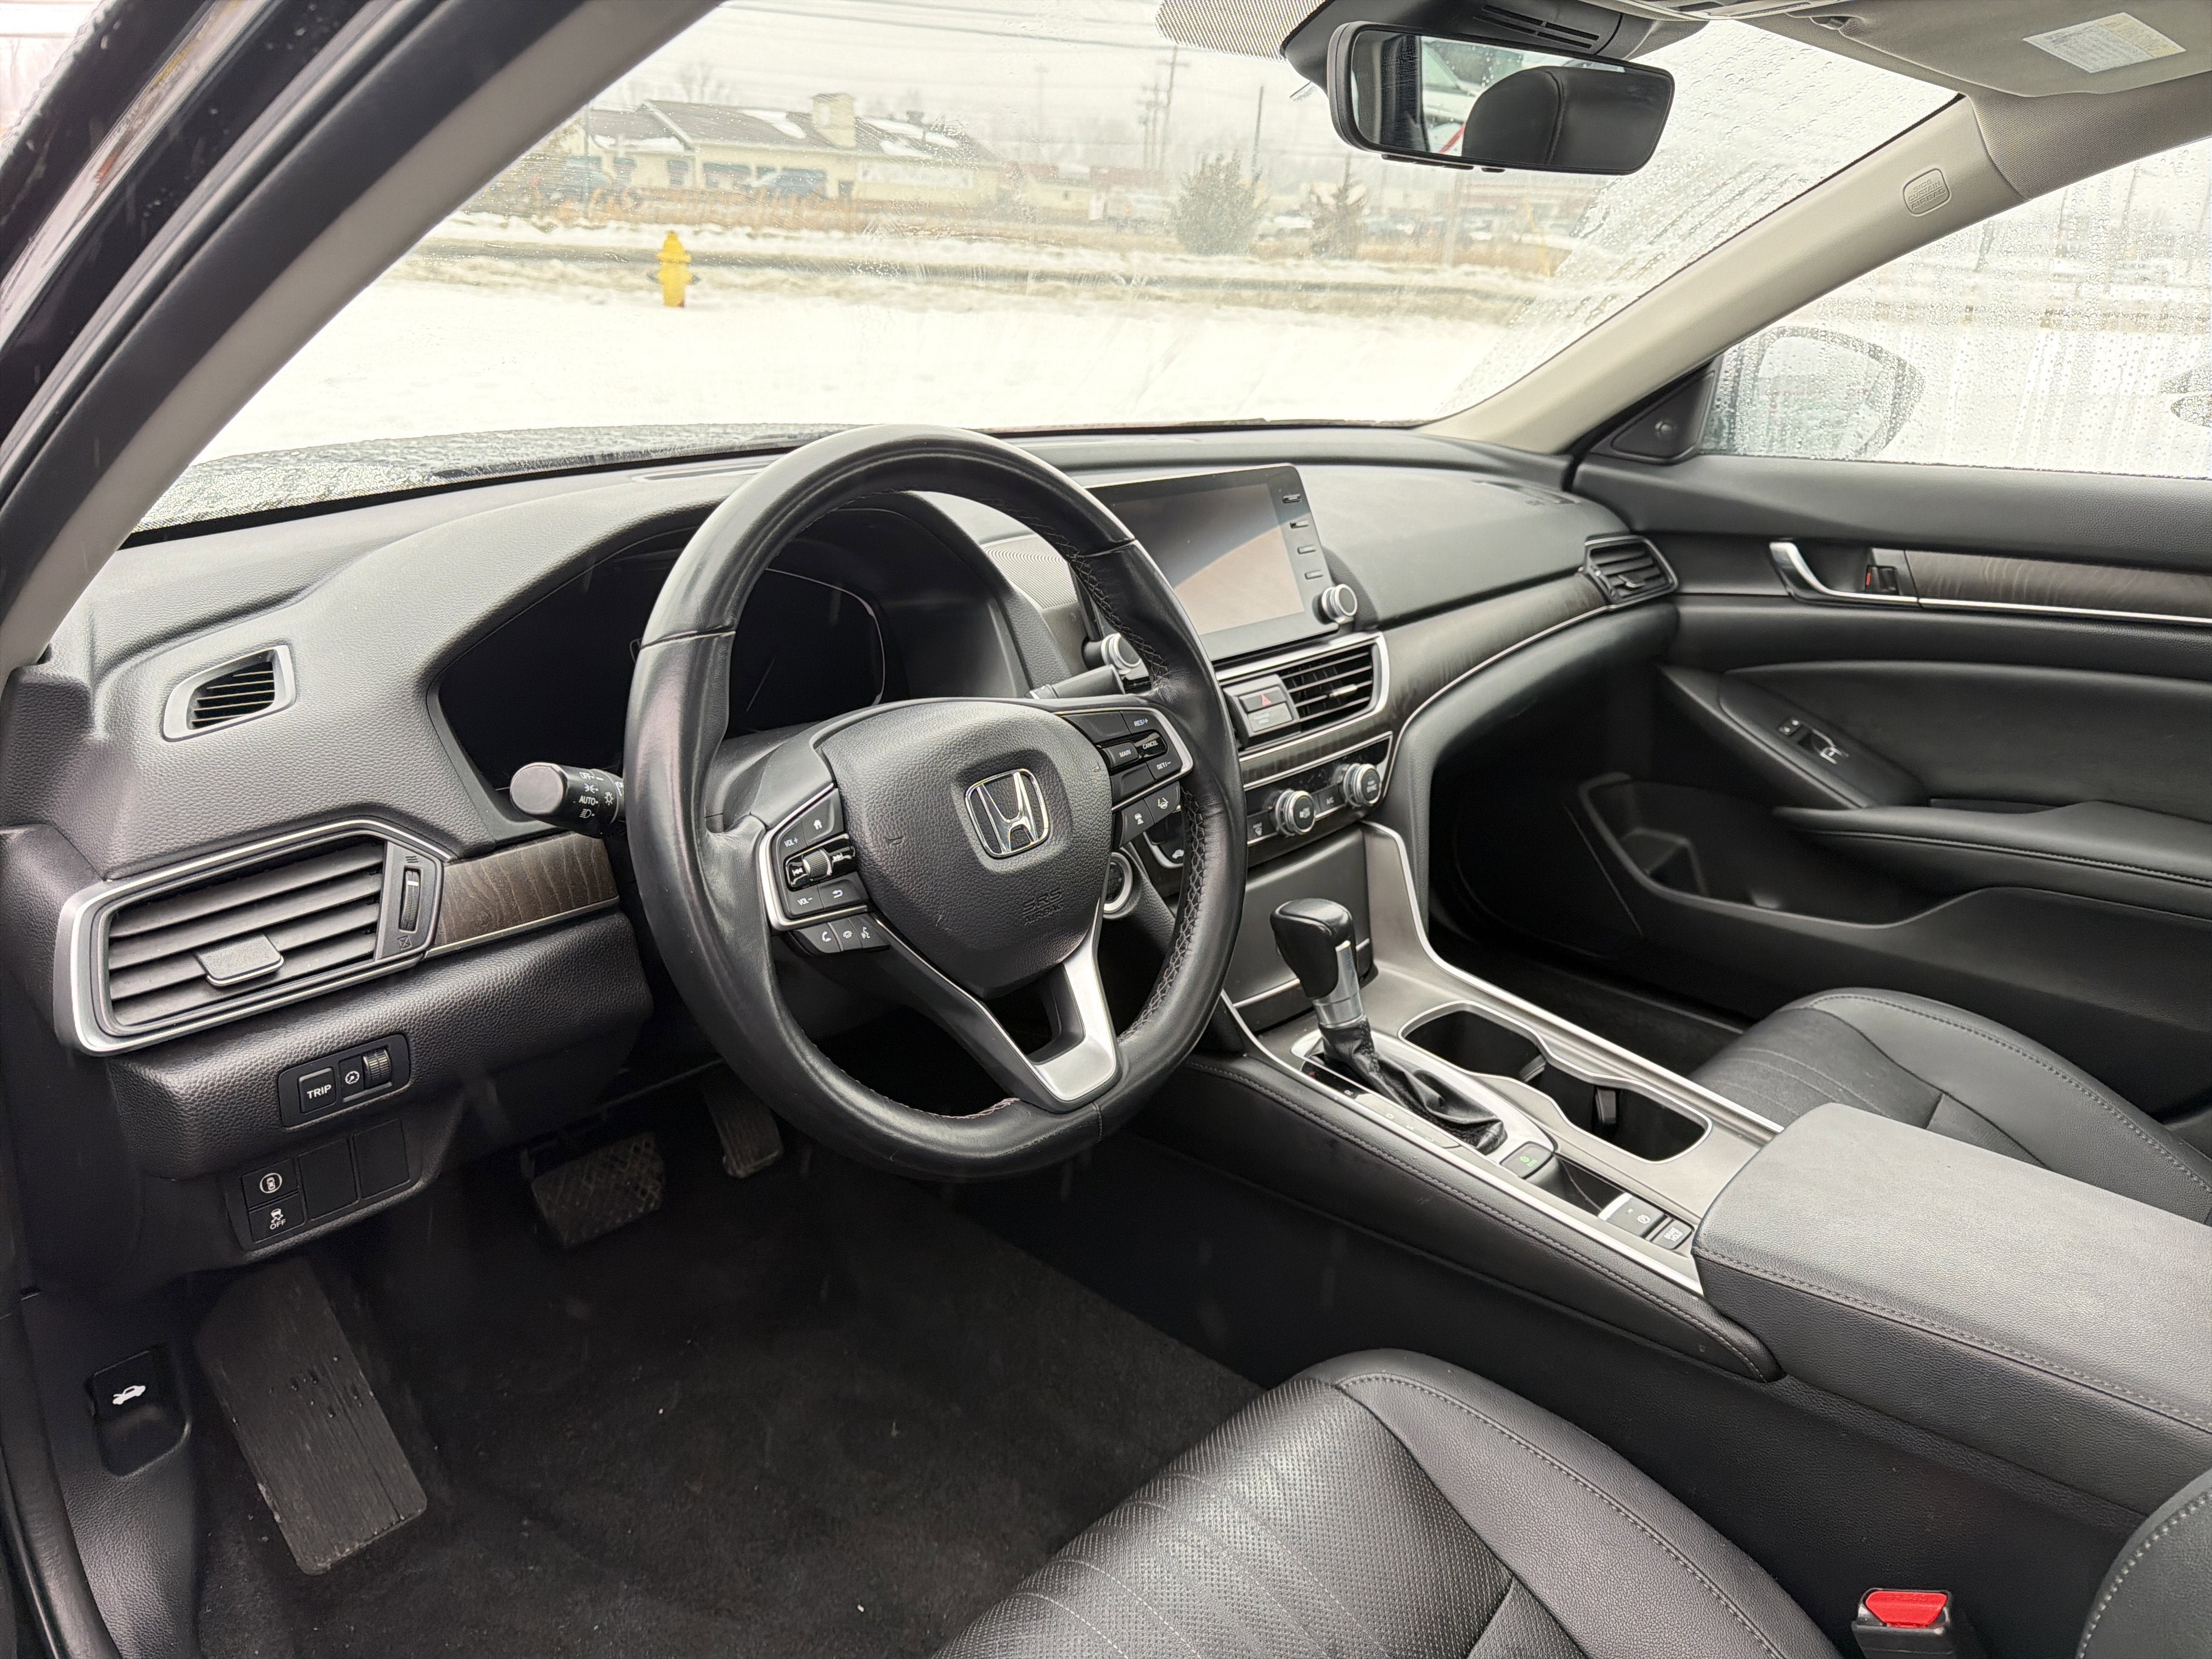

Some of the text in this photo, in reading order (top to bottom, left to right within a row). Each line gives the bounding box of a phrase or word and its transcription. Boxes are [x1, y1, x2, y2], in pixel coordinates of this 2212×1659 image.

[1908, 181, 1941, 201] CURTAIN
[1913, 179, 1932, 193] SIDE
[1911, 188, 1945, 210] AIRBAG
[1142, 740, 1158, 749] CANCEL
[1119, 749, 1132, 758] MAIN
[579, 771, 591, 780] OFF
[579, 795, 596, 806] AUTO
[1023, 887, 1063, 915] SRS
[307, 1084, 332, 1099] TRIP
[270, 1218, 286, 1230] OFF
